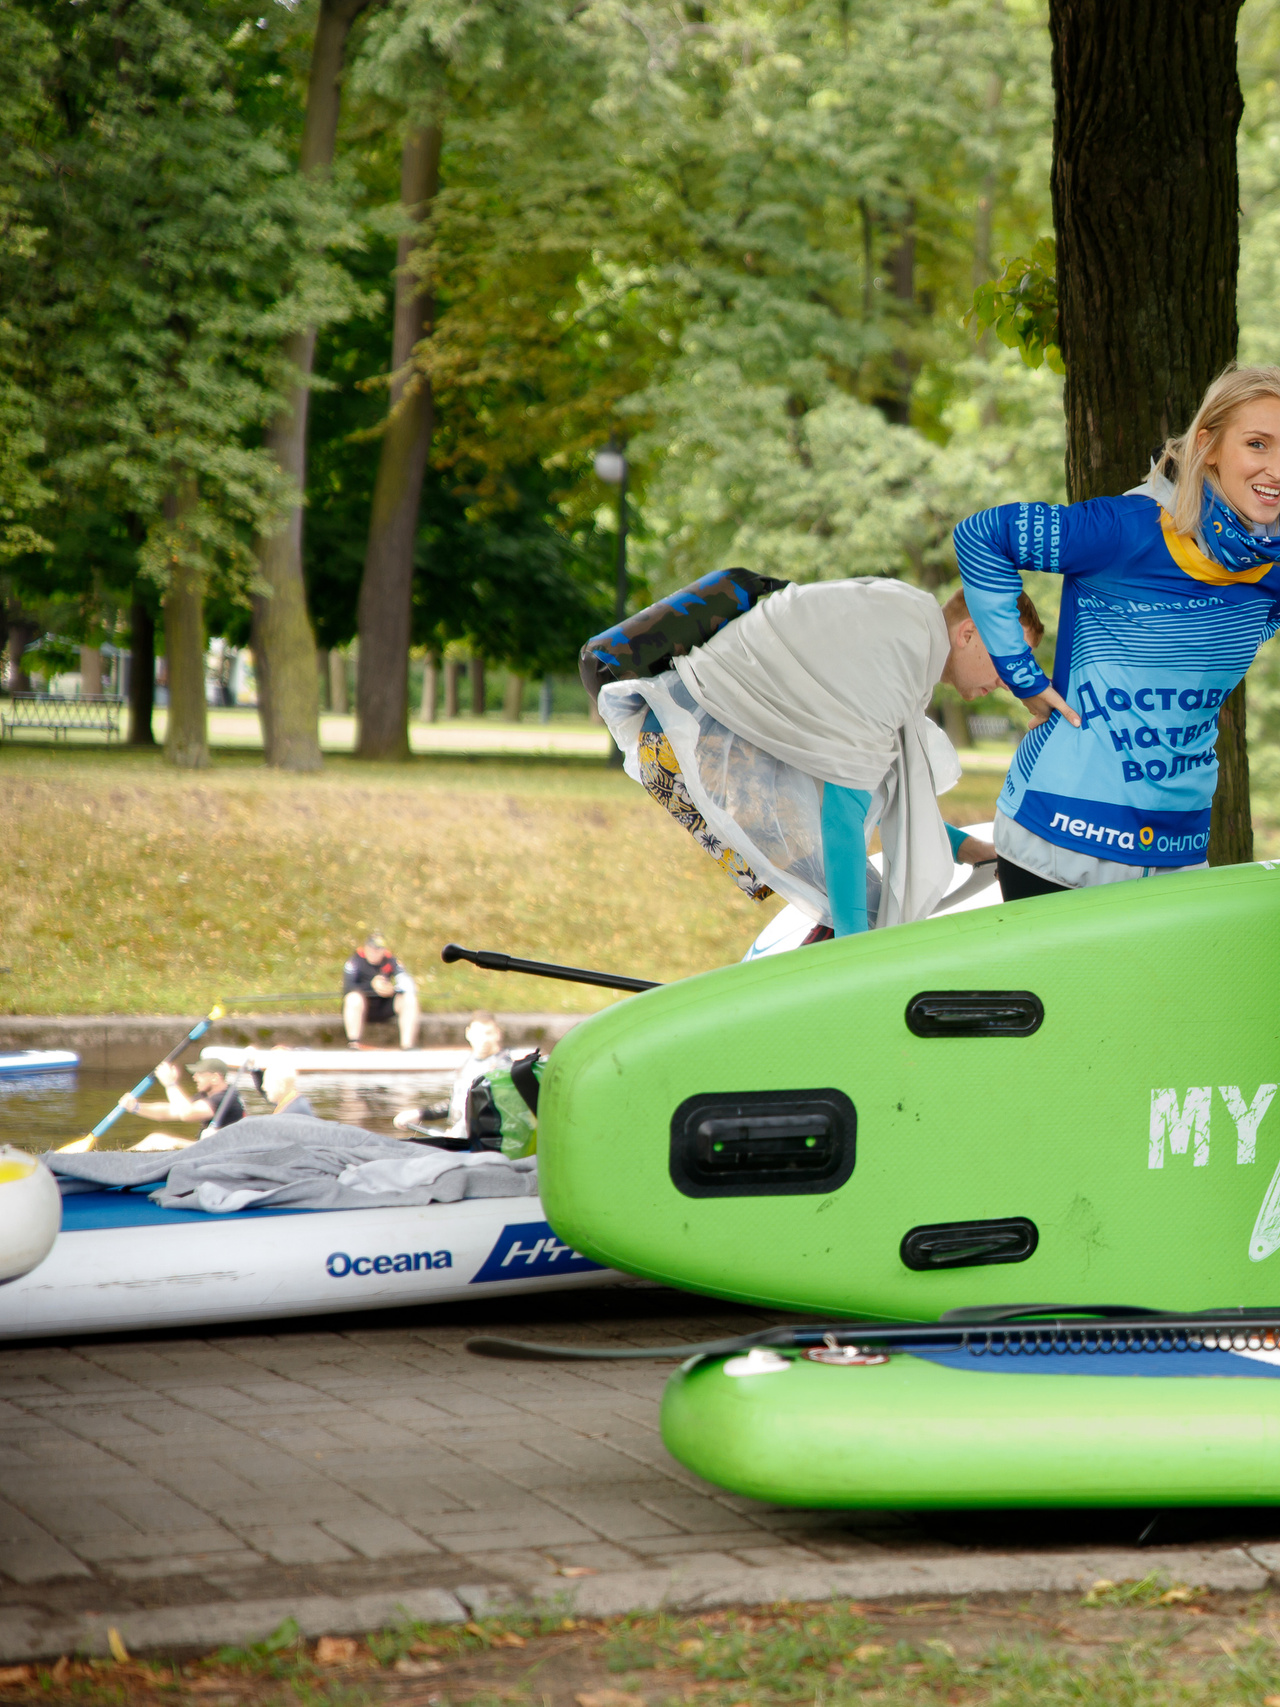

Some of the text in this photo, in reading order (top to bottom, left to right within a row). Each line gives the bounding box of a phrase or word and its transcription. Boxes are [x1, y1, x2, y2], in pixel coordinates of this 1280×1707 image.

[1048, 504, 1060, 573] оставляе
[1109, 726, 1161, 752] на
[1050, 812, 1134, 850] лента
[1147, 1082, 1280, 1169] MY
[326, 1250, 453, 1278] Oceana
[500, 1237, 584, 1267] HY
